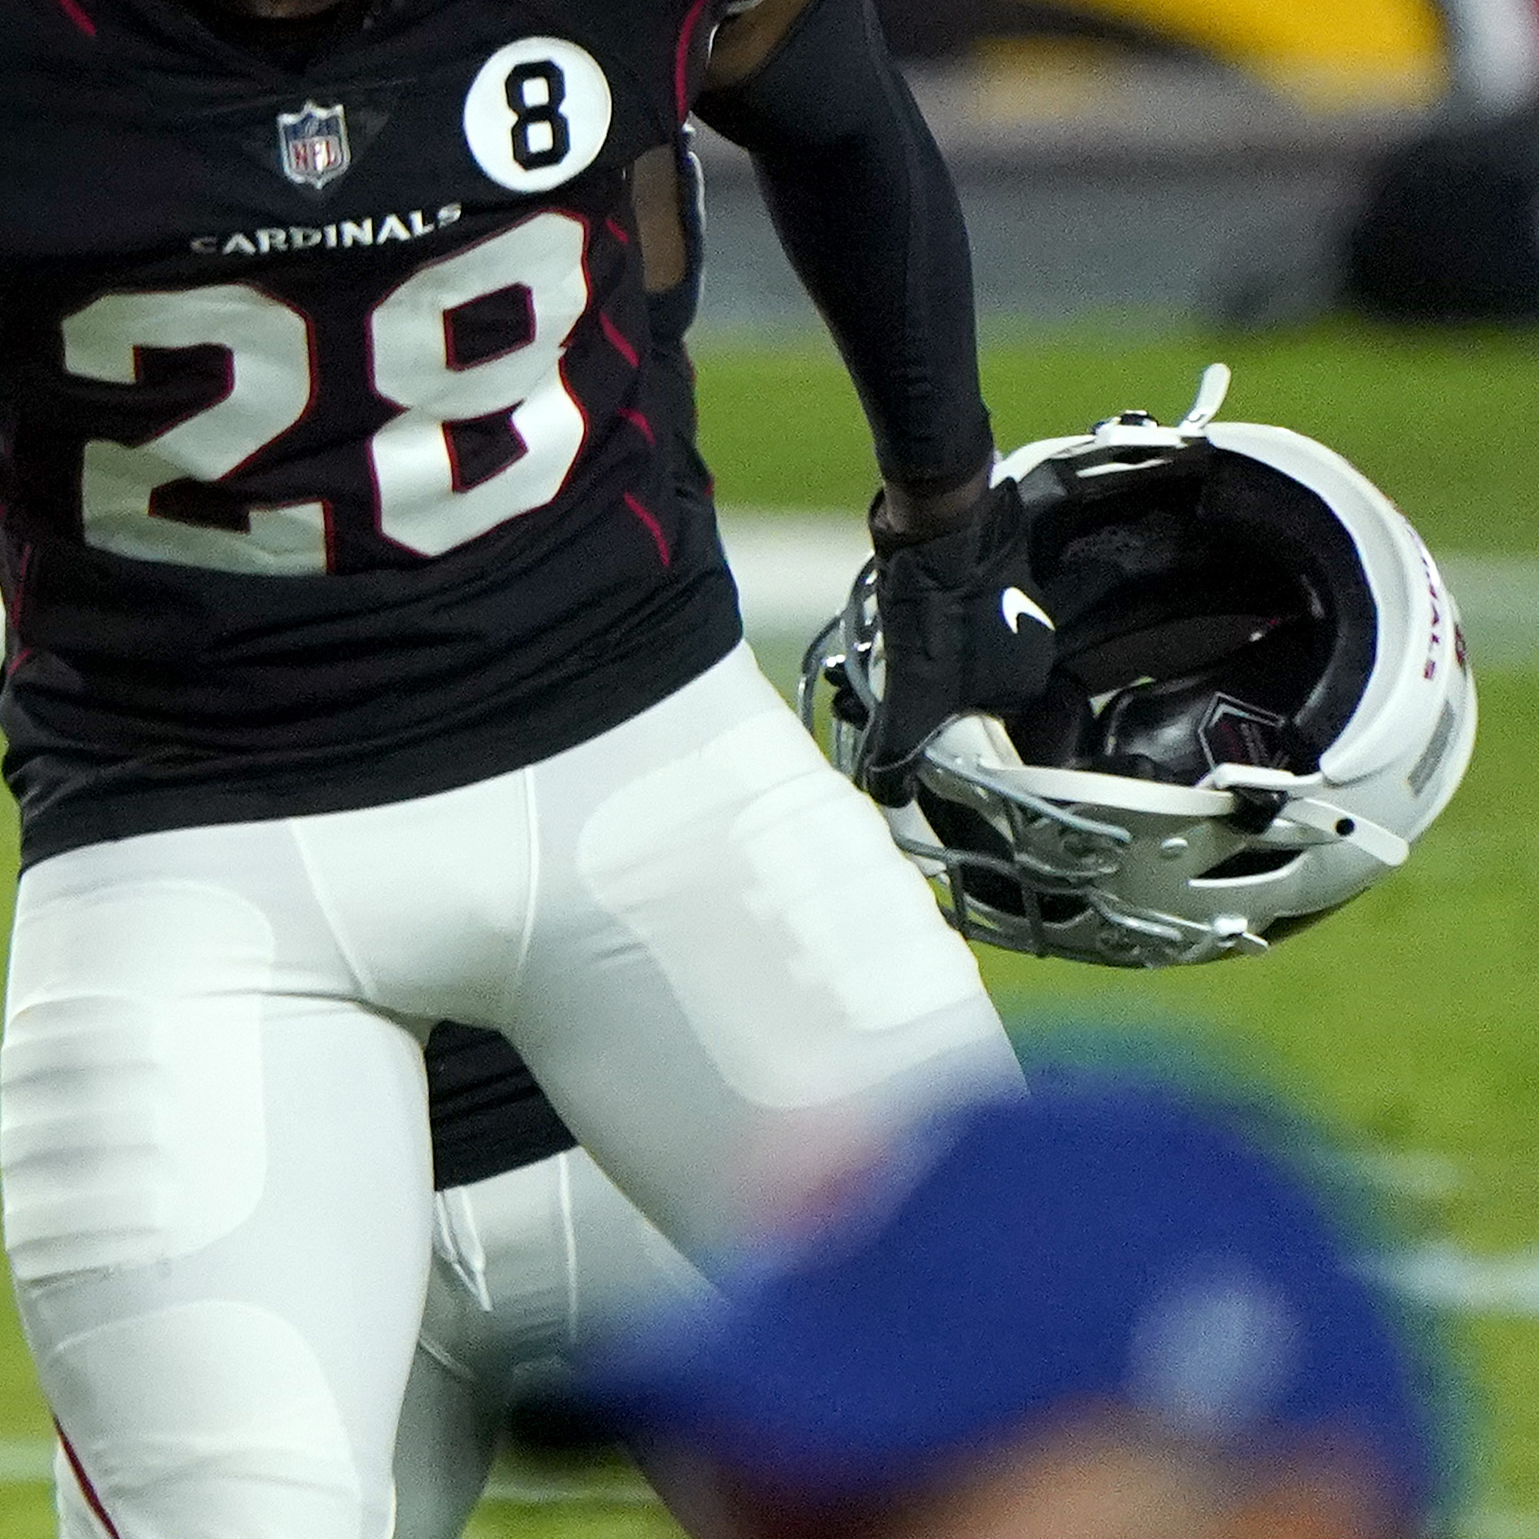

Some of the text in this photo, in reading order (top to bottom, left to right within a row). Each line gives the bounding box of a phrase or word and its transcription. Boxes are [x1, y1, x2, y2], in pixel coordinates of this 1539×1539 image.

[505, 57, 570, 172] 8
[190, 202, 462, 256] CARDINALS
[60, 210, 590, 577] 28
